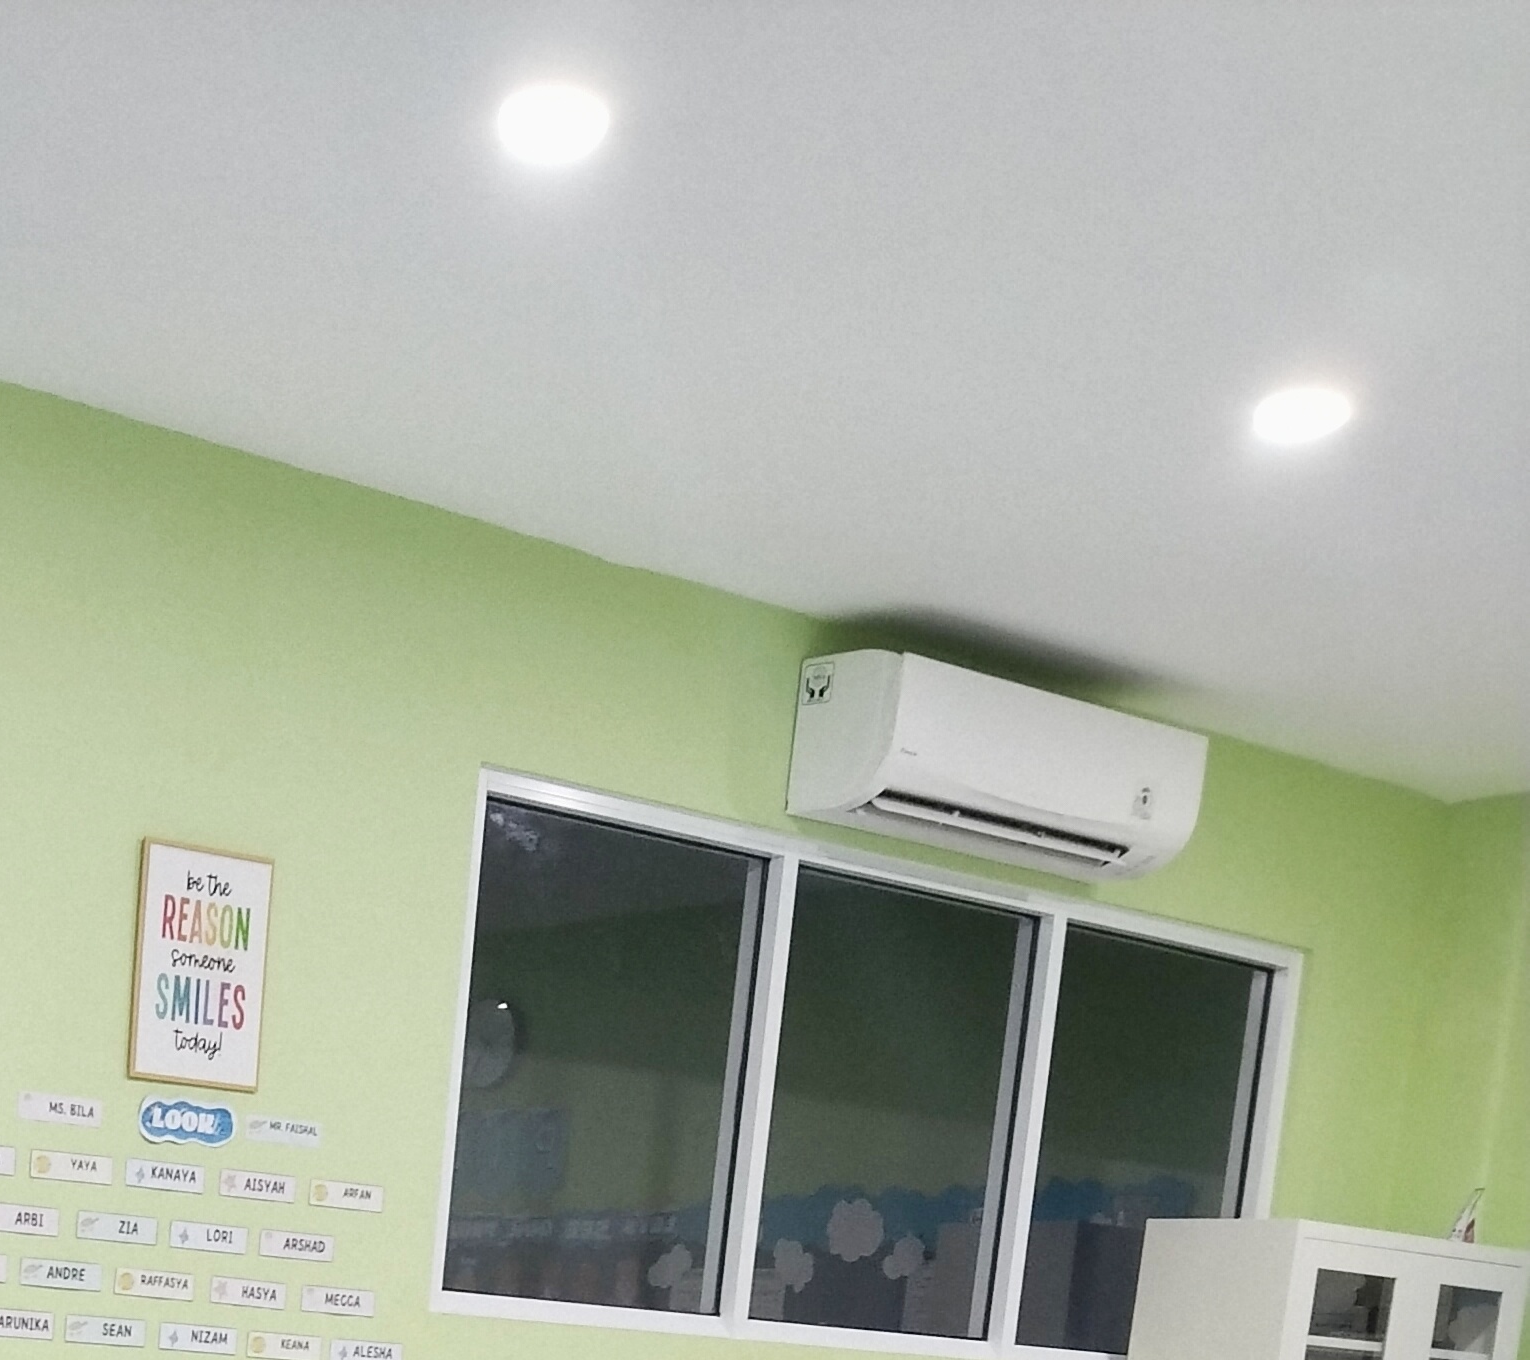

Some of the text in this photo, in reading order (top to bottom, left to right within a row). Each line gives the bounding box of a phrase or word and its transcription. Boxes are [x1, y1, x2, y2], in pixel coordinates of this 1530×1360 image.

[186, 870, 232, 897] be the
[161, 893, 251, 952] REASON
[170, 948, 236, 974] someone
[154, 972, 246, 1031] SMILES
[173, 1029, 223, 1061] today!
[48, 1102, 95, 1119] MS. BILA
[151, 1106, 216, 1135] LOOK
[71, 1158, 98, 1172] YAYA
[151, 1166, 197, 1184] KANAYA
[244, 1178, 286, 1195] AISYAH
[14, 1211, 44, 1228] ARBI
[118, 1220, 139, 1236] ZIA
[206, 1230, 233, 1244] LORI
[283, 1237, 326, 1254] ARSHAD
[46, 1265, 86, 1282] ANDRE
[140, 1274, 189, 1291] RAFFASYA
[241, 1285, 277, 1301] HASYA
[324, 1293, 361, 1308] MECCA
[101, 1322, 133, 1338] SEAN
[190, 1329, 229, 1345] NIZAM
[280, 1338, 310, 1352] KEANA
[353, 1345, 393, 1360] ALESHA
